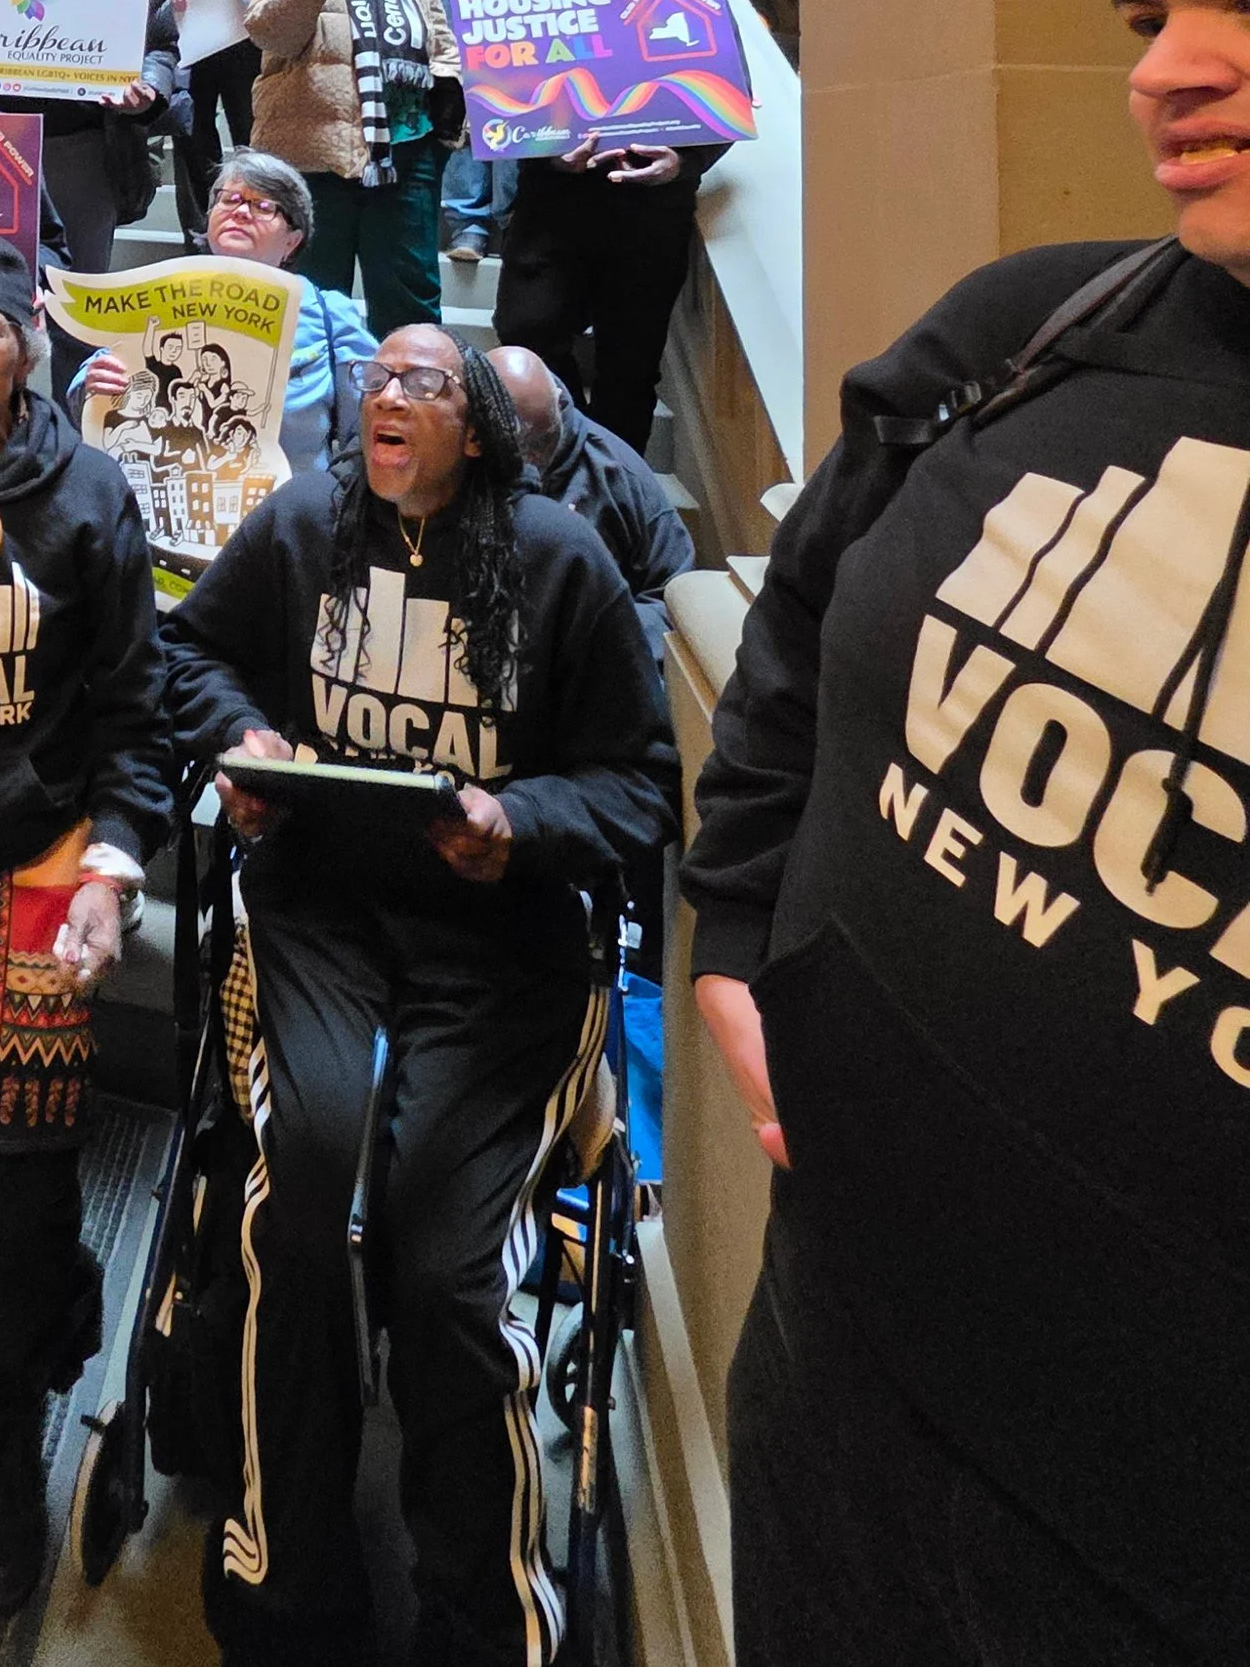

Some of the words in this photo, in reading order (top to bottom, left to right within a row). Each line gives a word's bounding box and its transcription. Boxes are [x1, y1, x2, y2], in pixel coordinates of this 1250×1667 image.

[462, 8, 599, 45] JUSTICE
[8, 50, 58, 62] EQUALITY
[60, 53, 103, 65] PROJECT
[465, 41, 539, 70] FOR
[545, 34, 613, 63] ALL
[74, 72, 104, 81] VOICES
[4, 140, 34, 177] POWER
[85, 290, 152, 314] MAKE
[154, 279, 202, 303] THE
[209, 280, 280, 312] ROAD
[172, 302, 217, 320] NEW
[223, 304, 275, 334] YORK
[312, 673, 513, 780] VOCAL
[878, 764, 1080, 949] NEW
[1130, 937, 1250, 1089] YO
